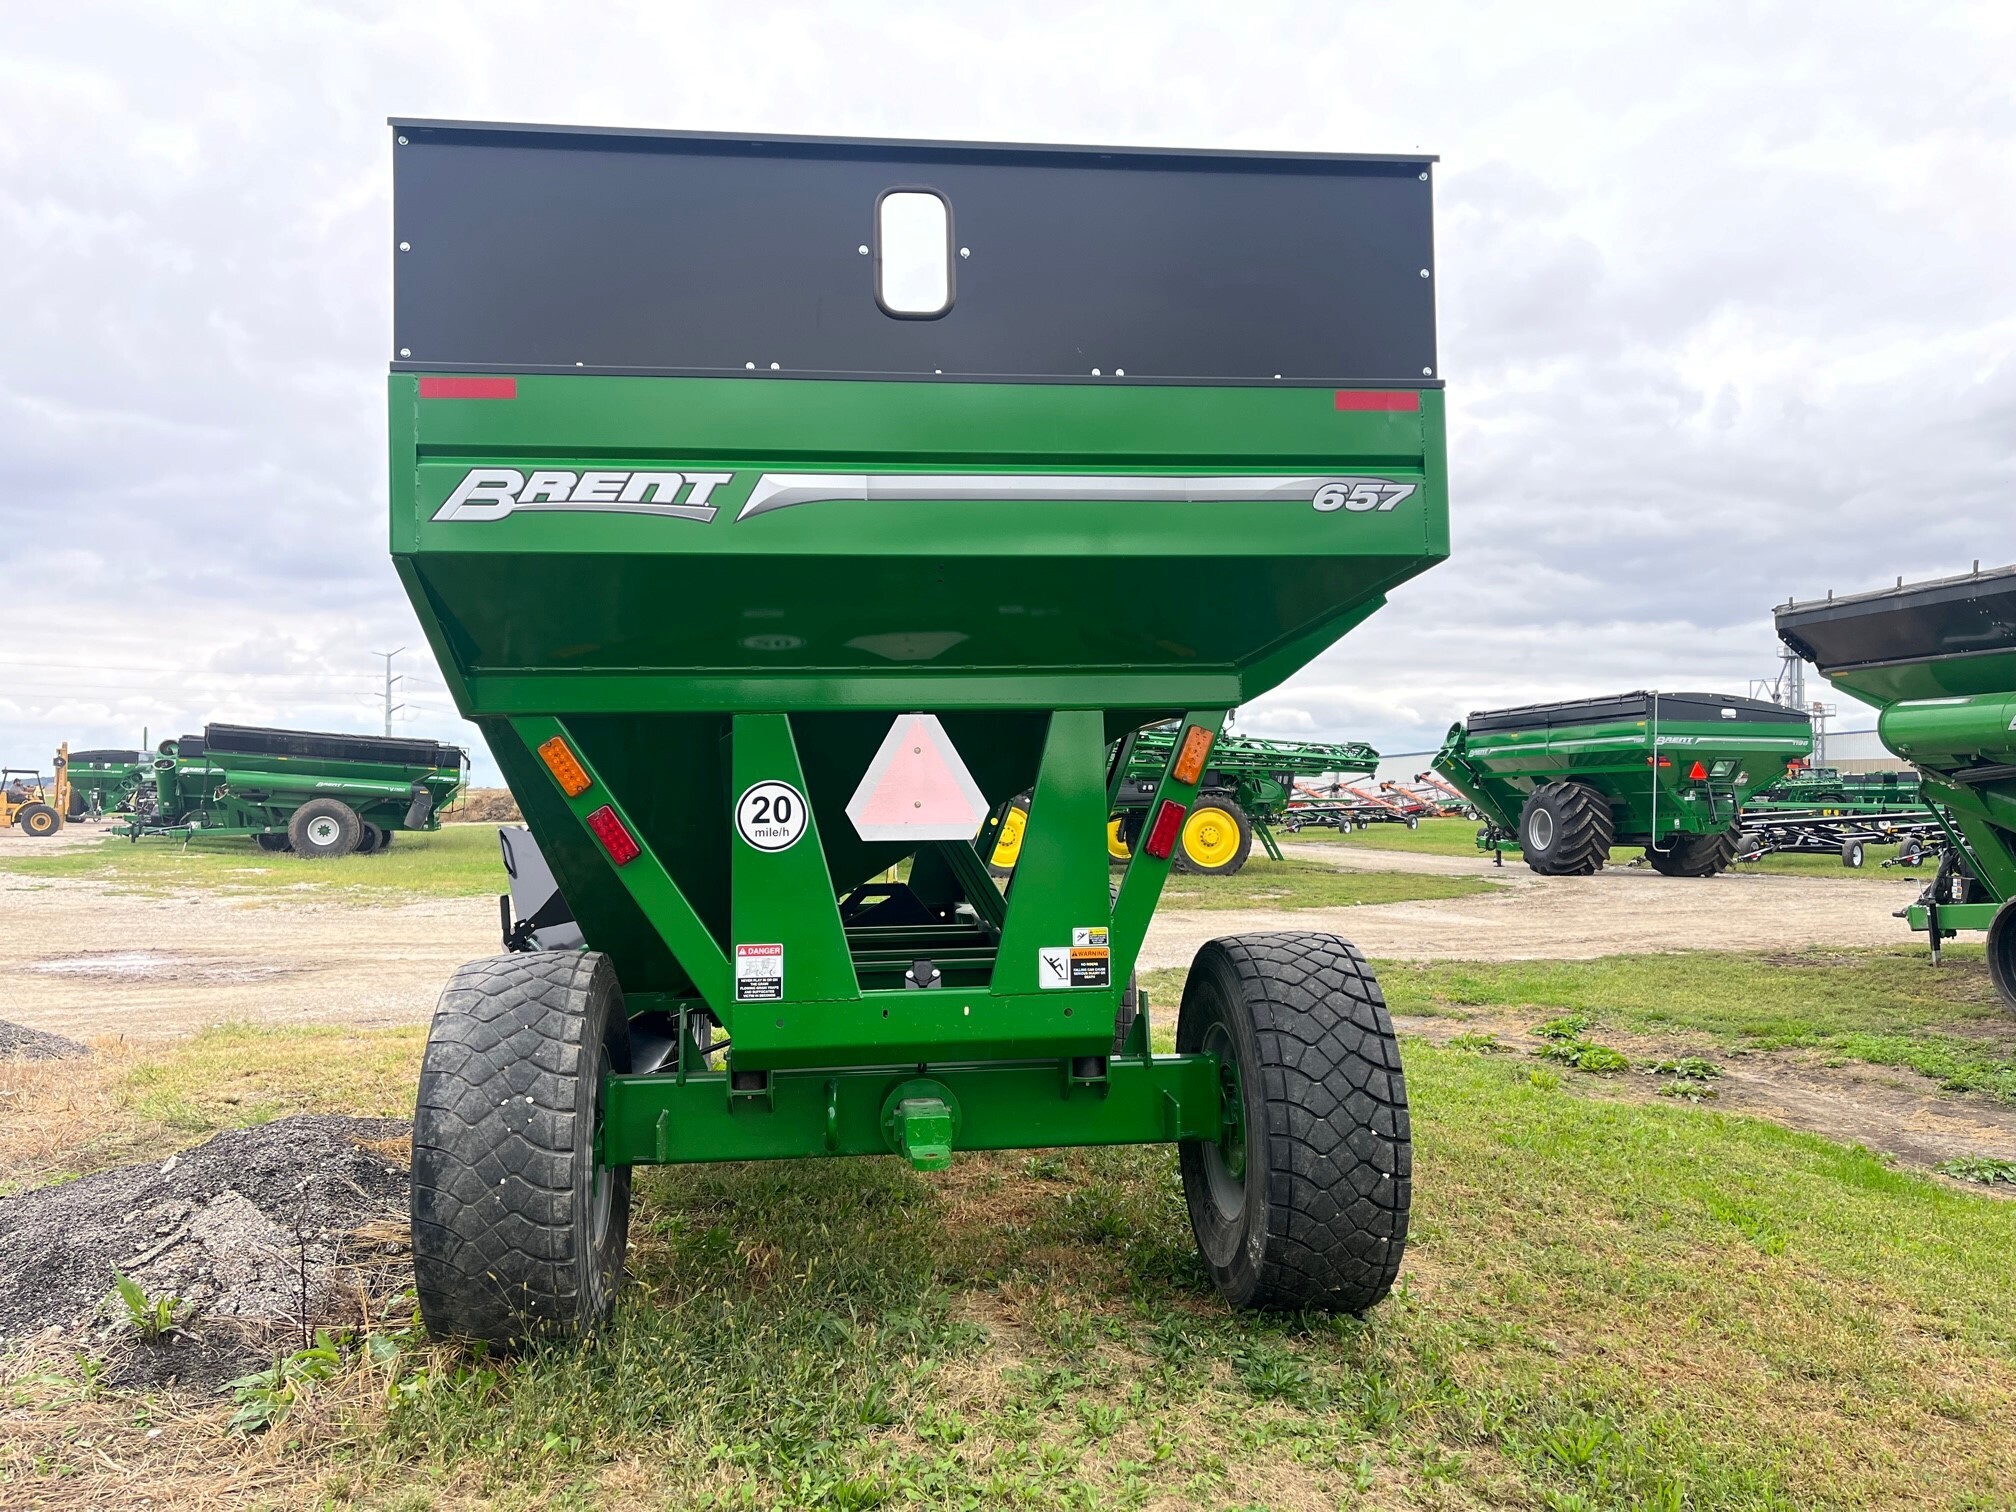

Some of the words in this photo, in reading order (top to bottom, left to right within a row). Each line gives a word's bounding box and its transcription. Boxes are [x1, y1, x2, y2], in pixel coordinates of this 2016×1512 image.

[429, 467, 736, 522] BRENT
[1312, 482, 1418, 512] 657
[1654, 736, 1694, 746] BRENT
[751, 795, 792, 825] 20
[754, 827, 790, 838] mile/h
